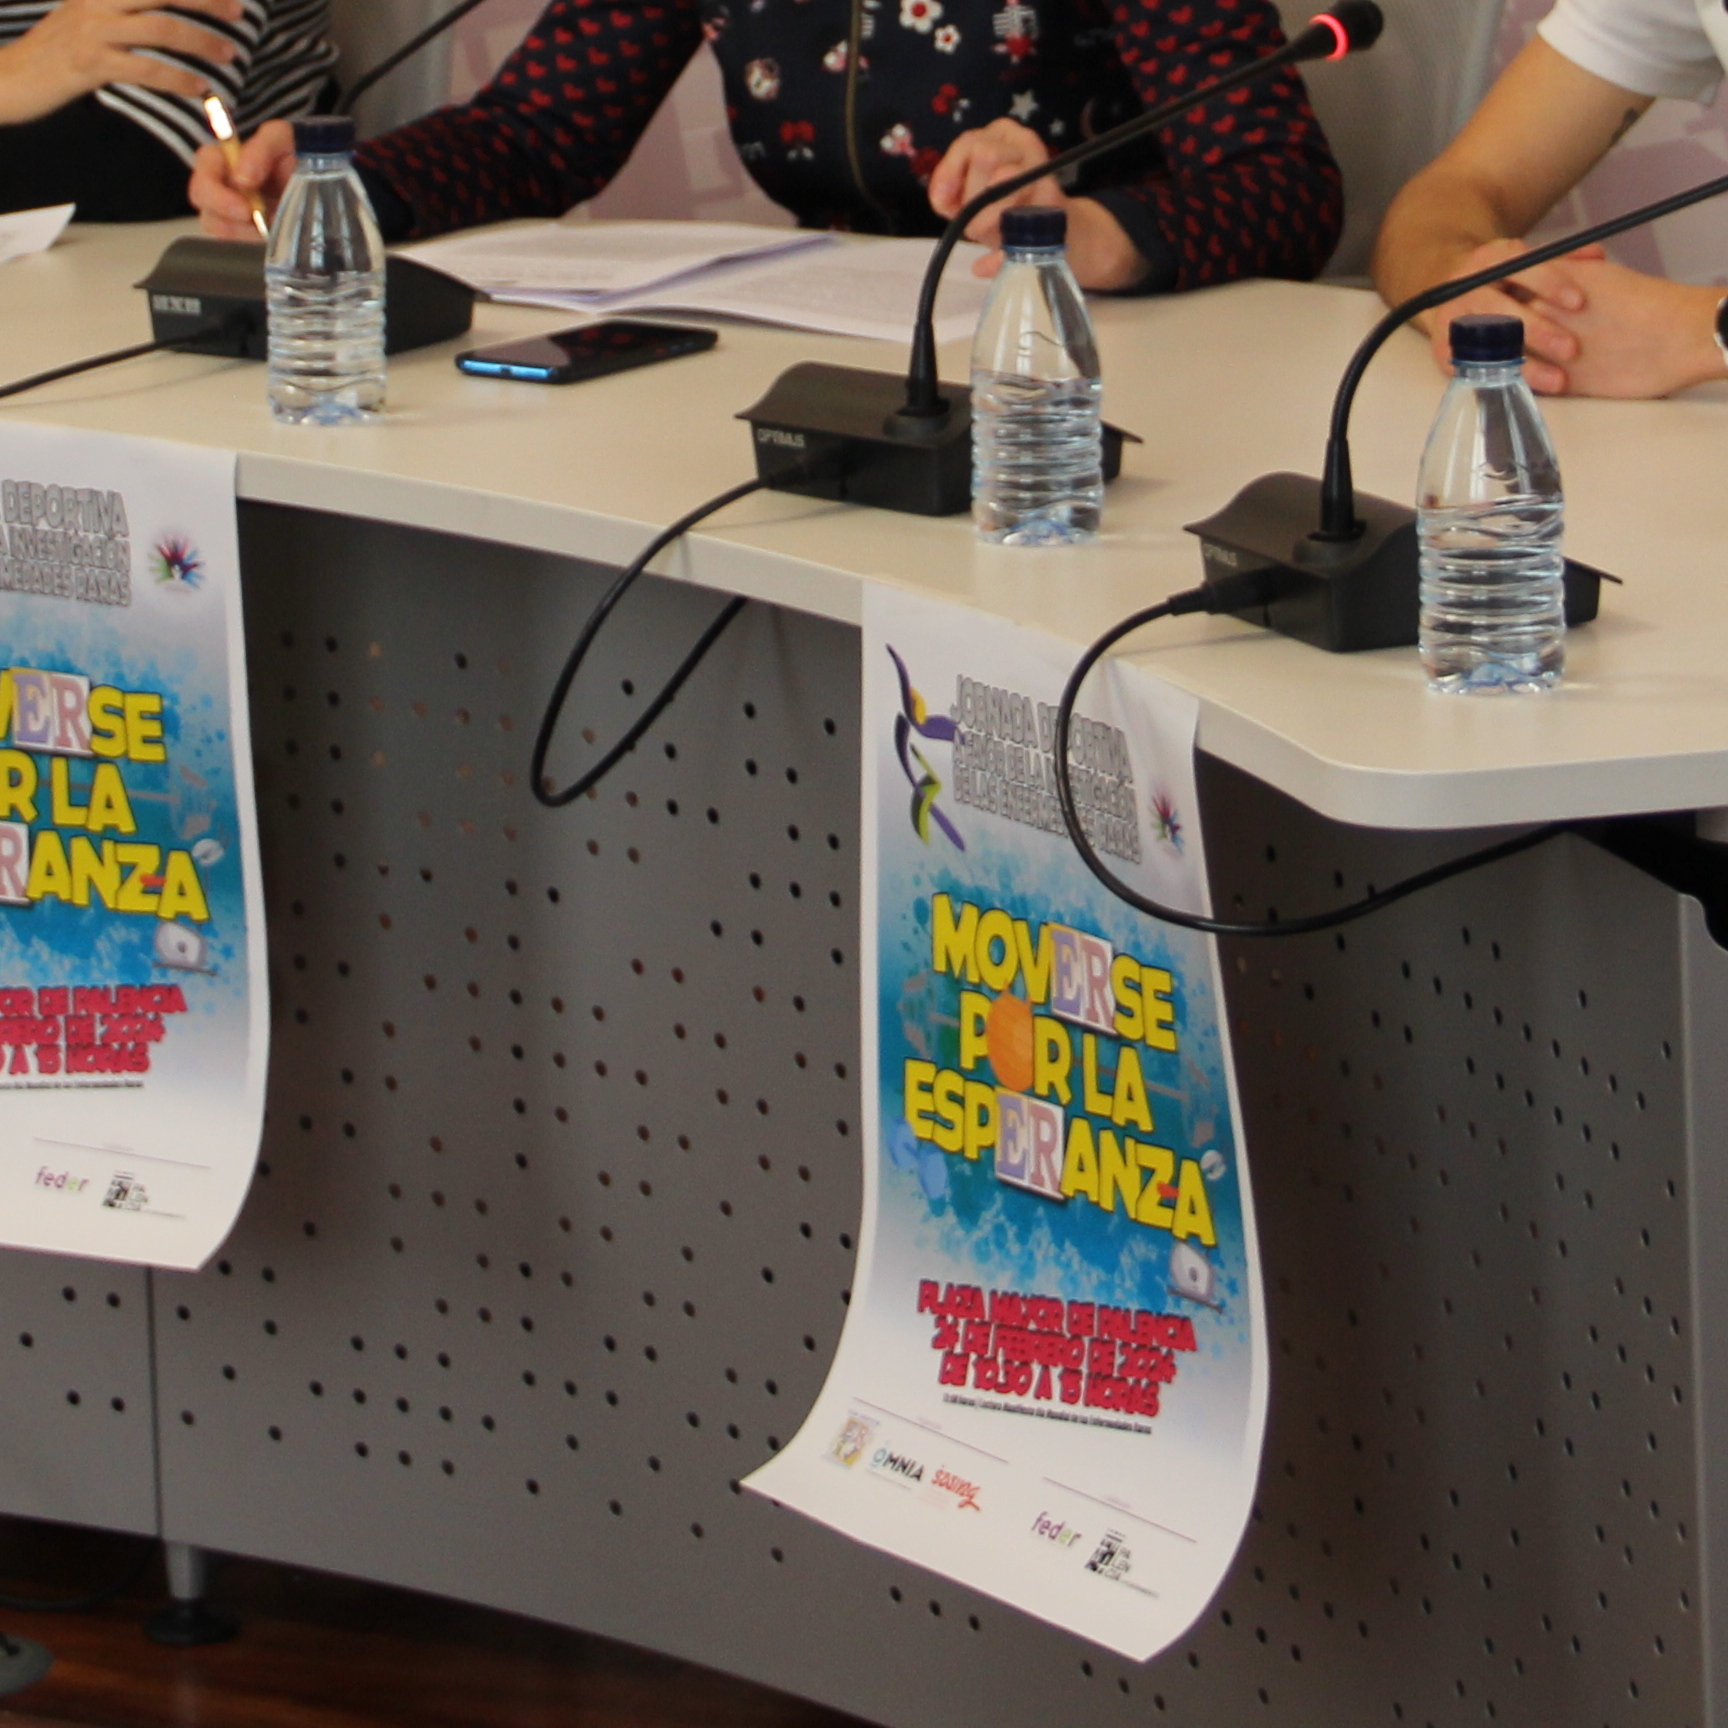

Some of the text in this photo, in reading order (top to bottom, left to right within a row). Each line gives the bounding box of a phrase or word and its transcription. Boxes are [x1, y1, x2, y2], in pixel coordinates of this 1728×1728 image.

[50, 755, 138, 834] LA
[931, 891, 1178, 1053] MOVERSE
[1082, 1032, 1155, 1133] LA
[34, 1165, 90, 1193] feder
[904, 1057, 1218, 1248] ESPERANZA
[1030, 1511, 1083, 1549] feder
